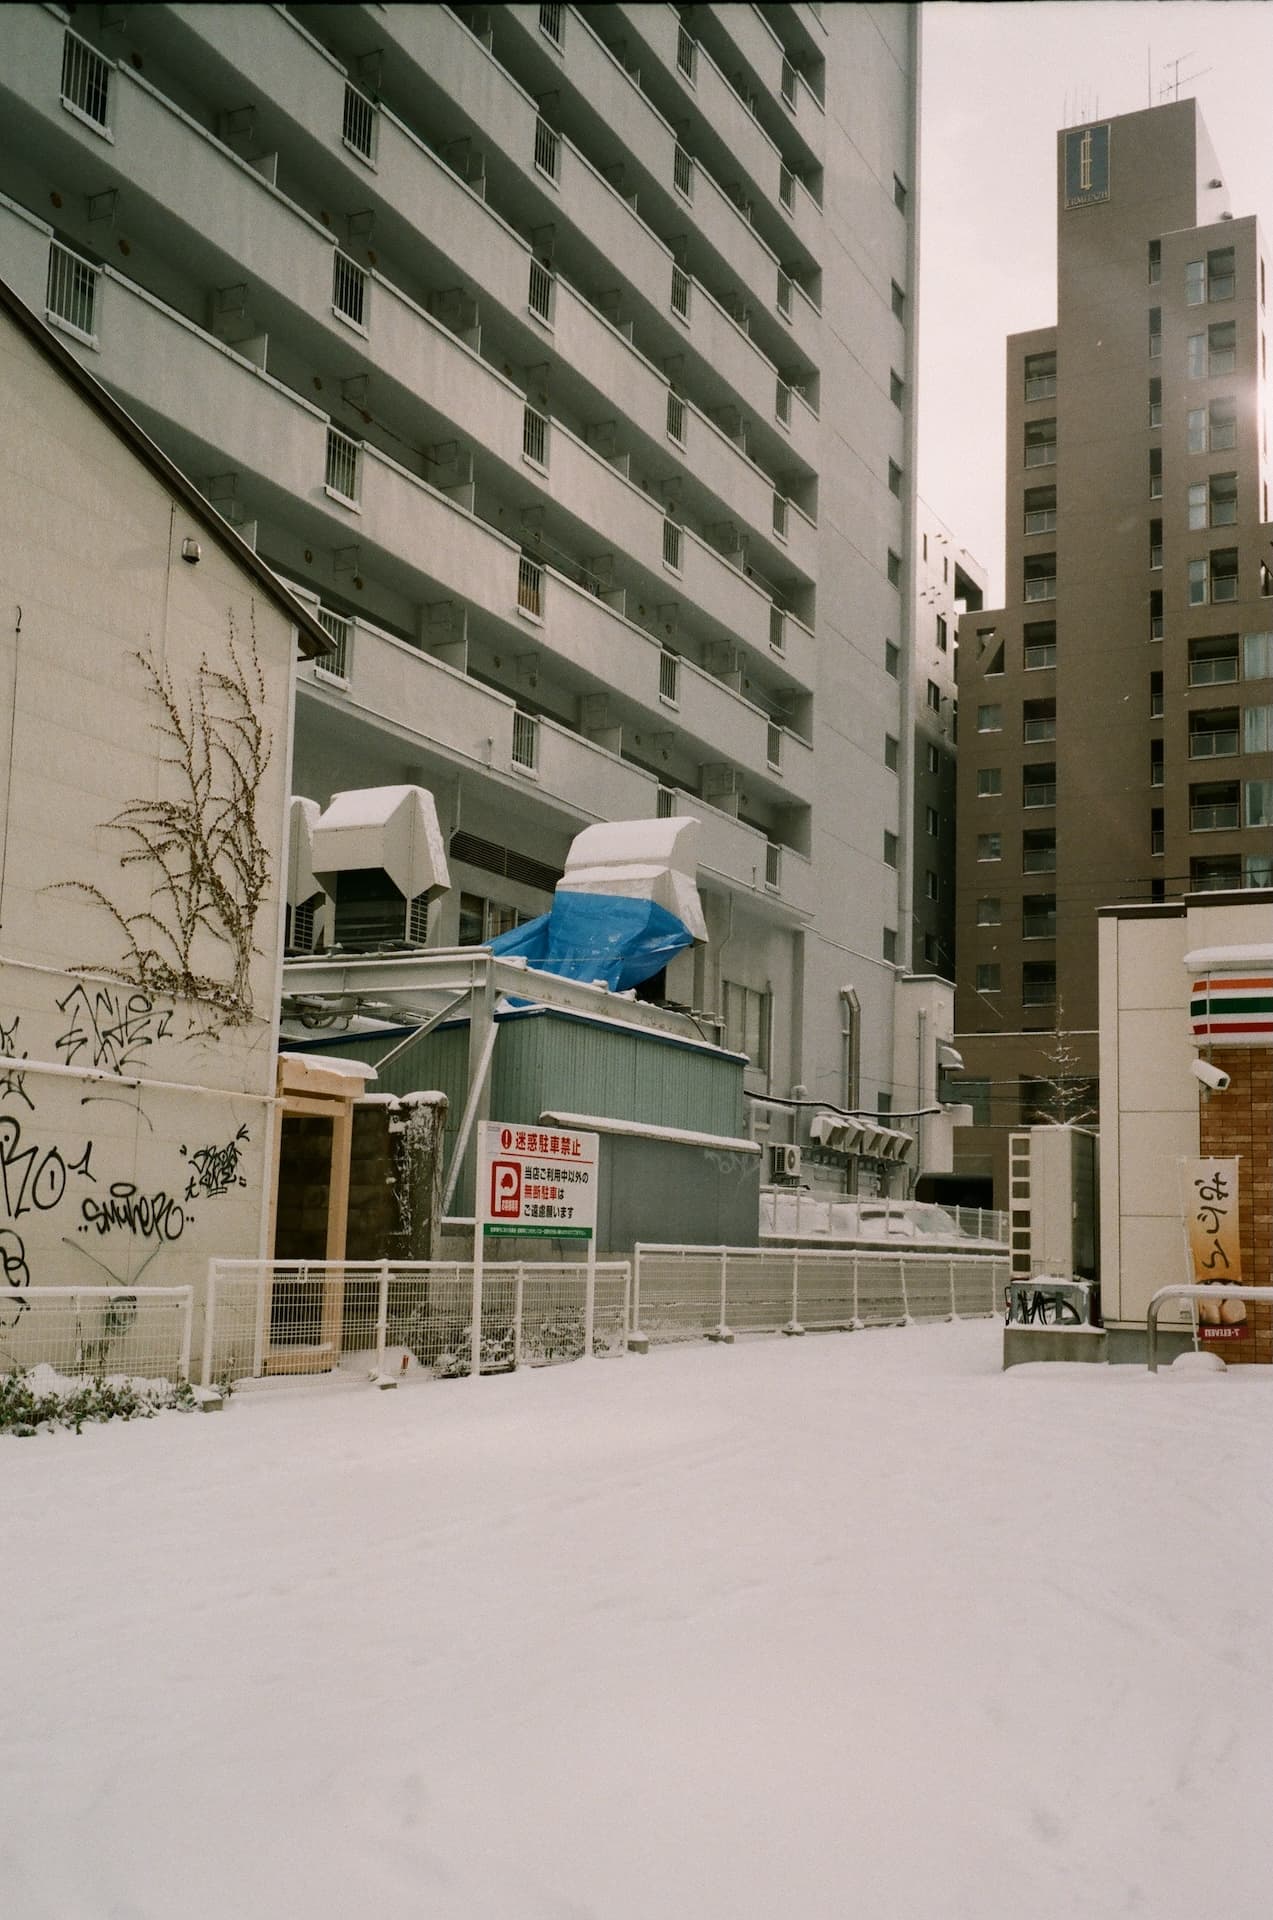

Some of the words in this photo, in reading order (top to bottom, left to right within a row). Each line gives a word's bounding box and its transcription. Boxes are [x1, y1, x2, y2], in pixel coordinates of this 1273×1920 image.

[515, 1131, 581, 1156] 迷惑駐車禁止
[524, 1166, 589, 1184] 当店ご利用中以外の
[524, 1184, 565, 1200] 無断駐車は
[524, 1204, 574, 1219] ご遠慮願います
